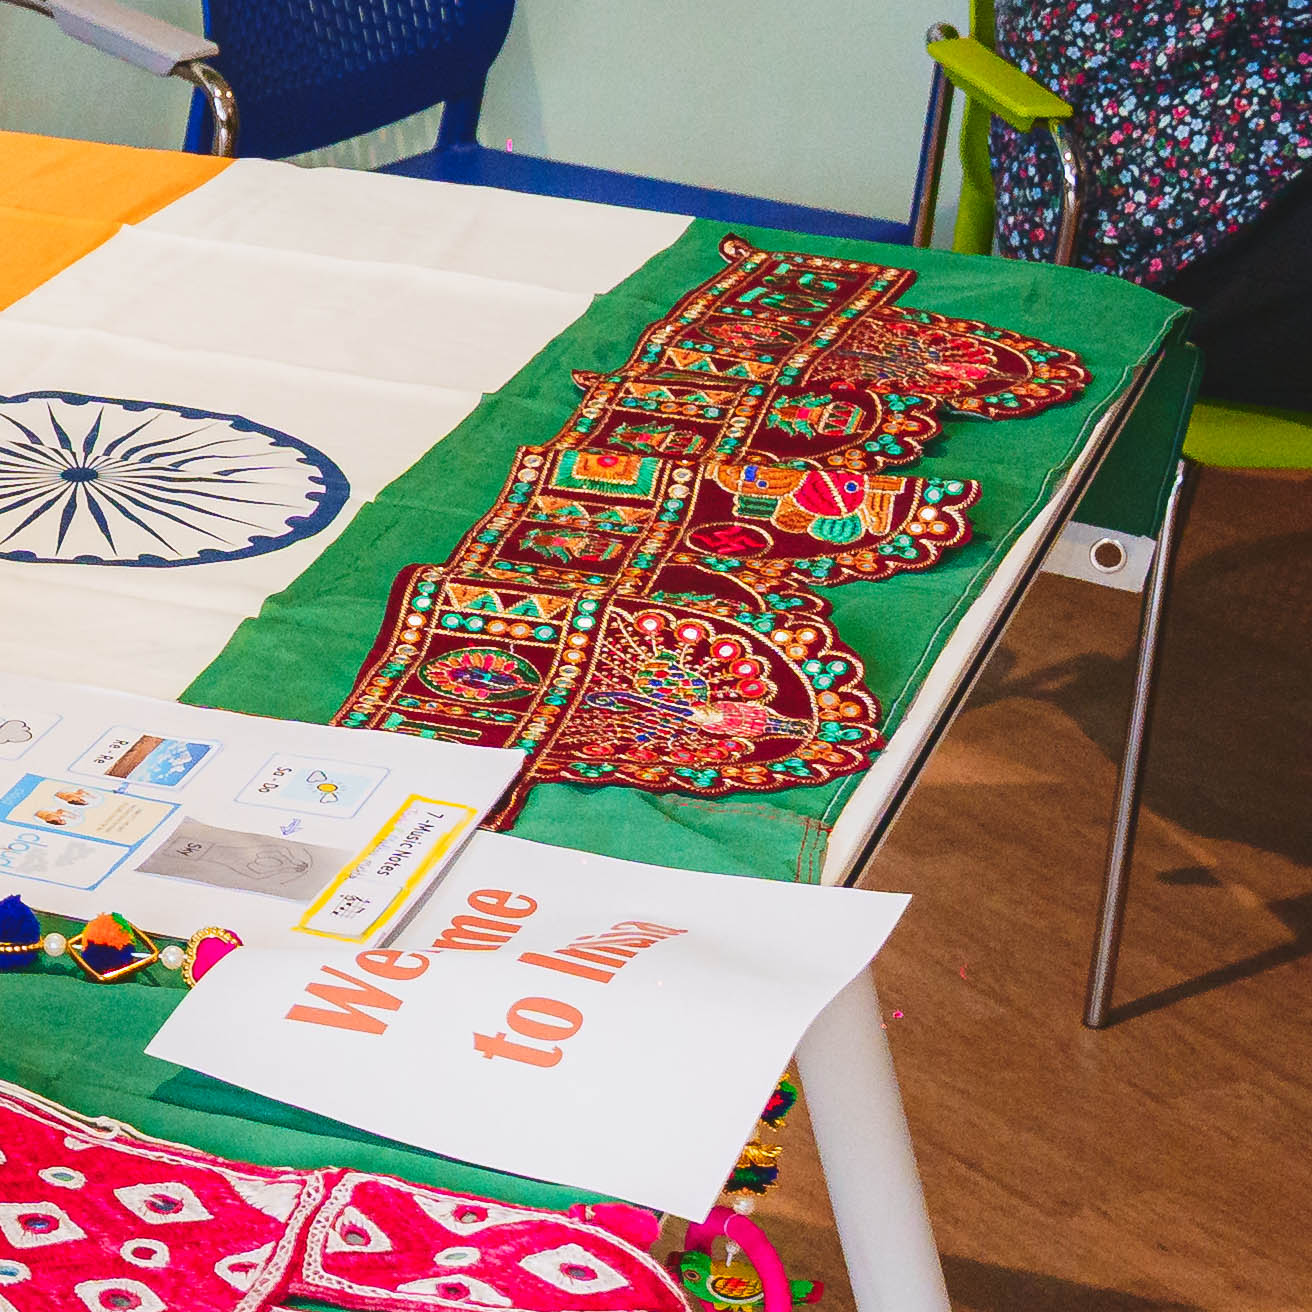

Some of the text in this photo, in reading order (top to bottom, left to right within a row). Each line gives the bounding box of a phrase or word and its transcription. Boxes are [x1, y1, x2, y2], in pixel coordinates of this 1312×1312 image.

[109, 738, 129, 749] Re
[93, 753, 114, 764] Re
[273, 766, 293, 777] Sa
[176, 842, 202, 858] Sky
[376, 849, 412, 877] Notes
[284, 888, 538, 1036] Weme
[473, 996, 584, 1068] to
